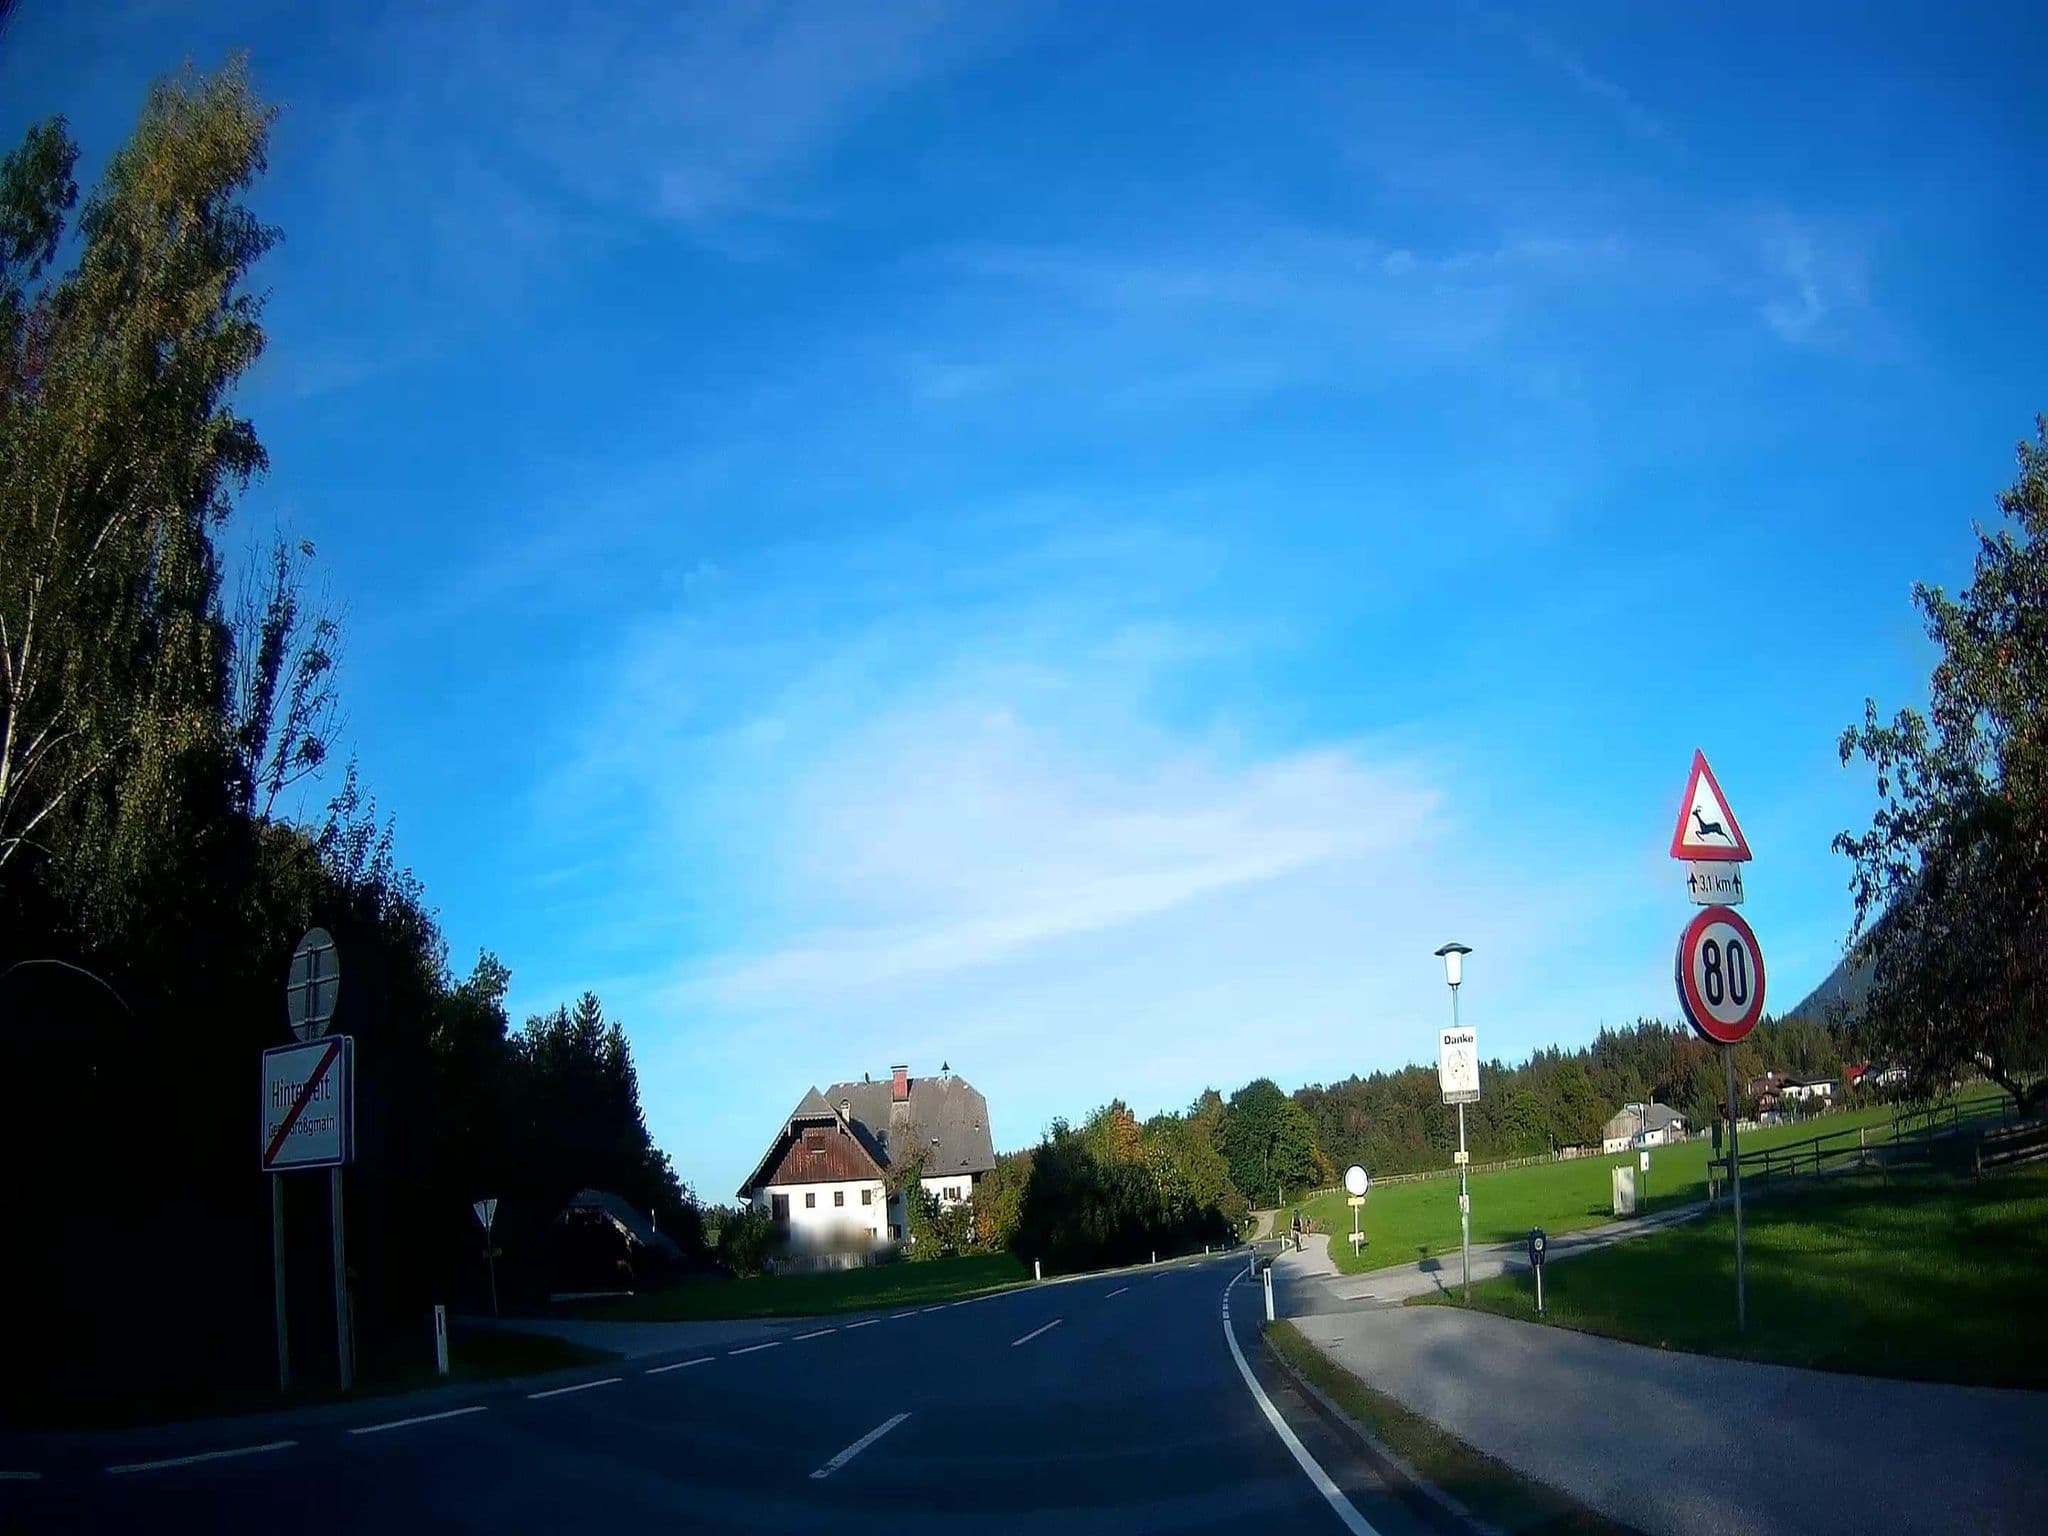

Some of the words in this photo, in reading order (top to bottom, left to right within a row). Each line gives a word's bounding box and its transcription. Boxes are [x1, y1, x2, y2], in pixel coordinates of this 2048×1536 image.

[1715, 875, 1731, 892] km
[1702, 938, 1748, 1006] 80
[1444, 1033, 1474, 1045] Danke
